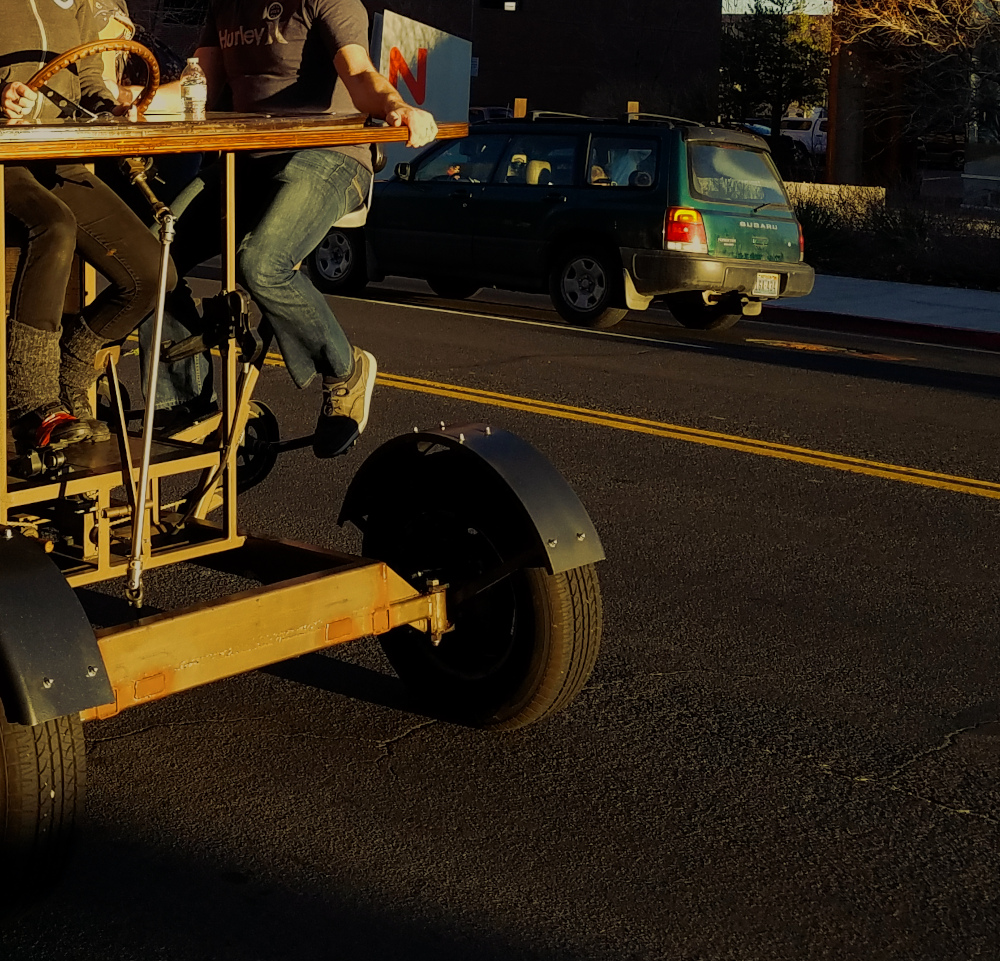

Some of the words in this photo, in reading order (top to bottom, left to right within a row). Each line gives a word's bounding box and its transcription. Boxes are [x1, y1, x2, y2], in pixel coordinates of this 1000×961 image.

[218, 24, 266, 50] Hurley
[388, 46, 428, 106] N
[739, 220, 778, 231] SUBARU
